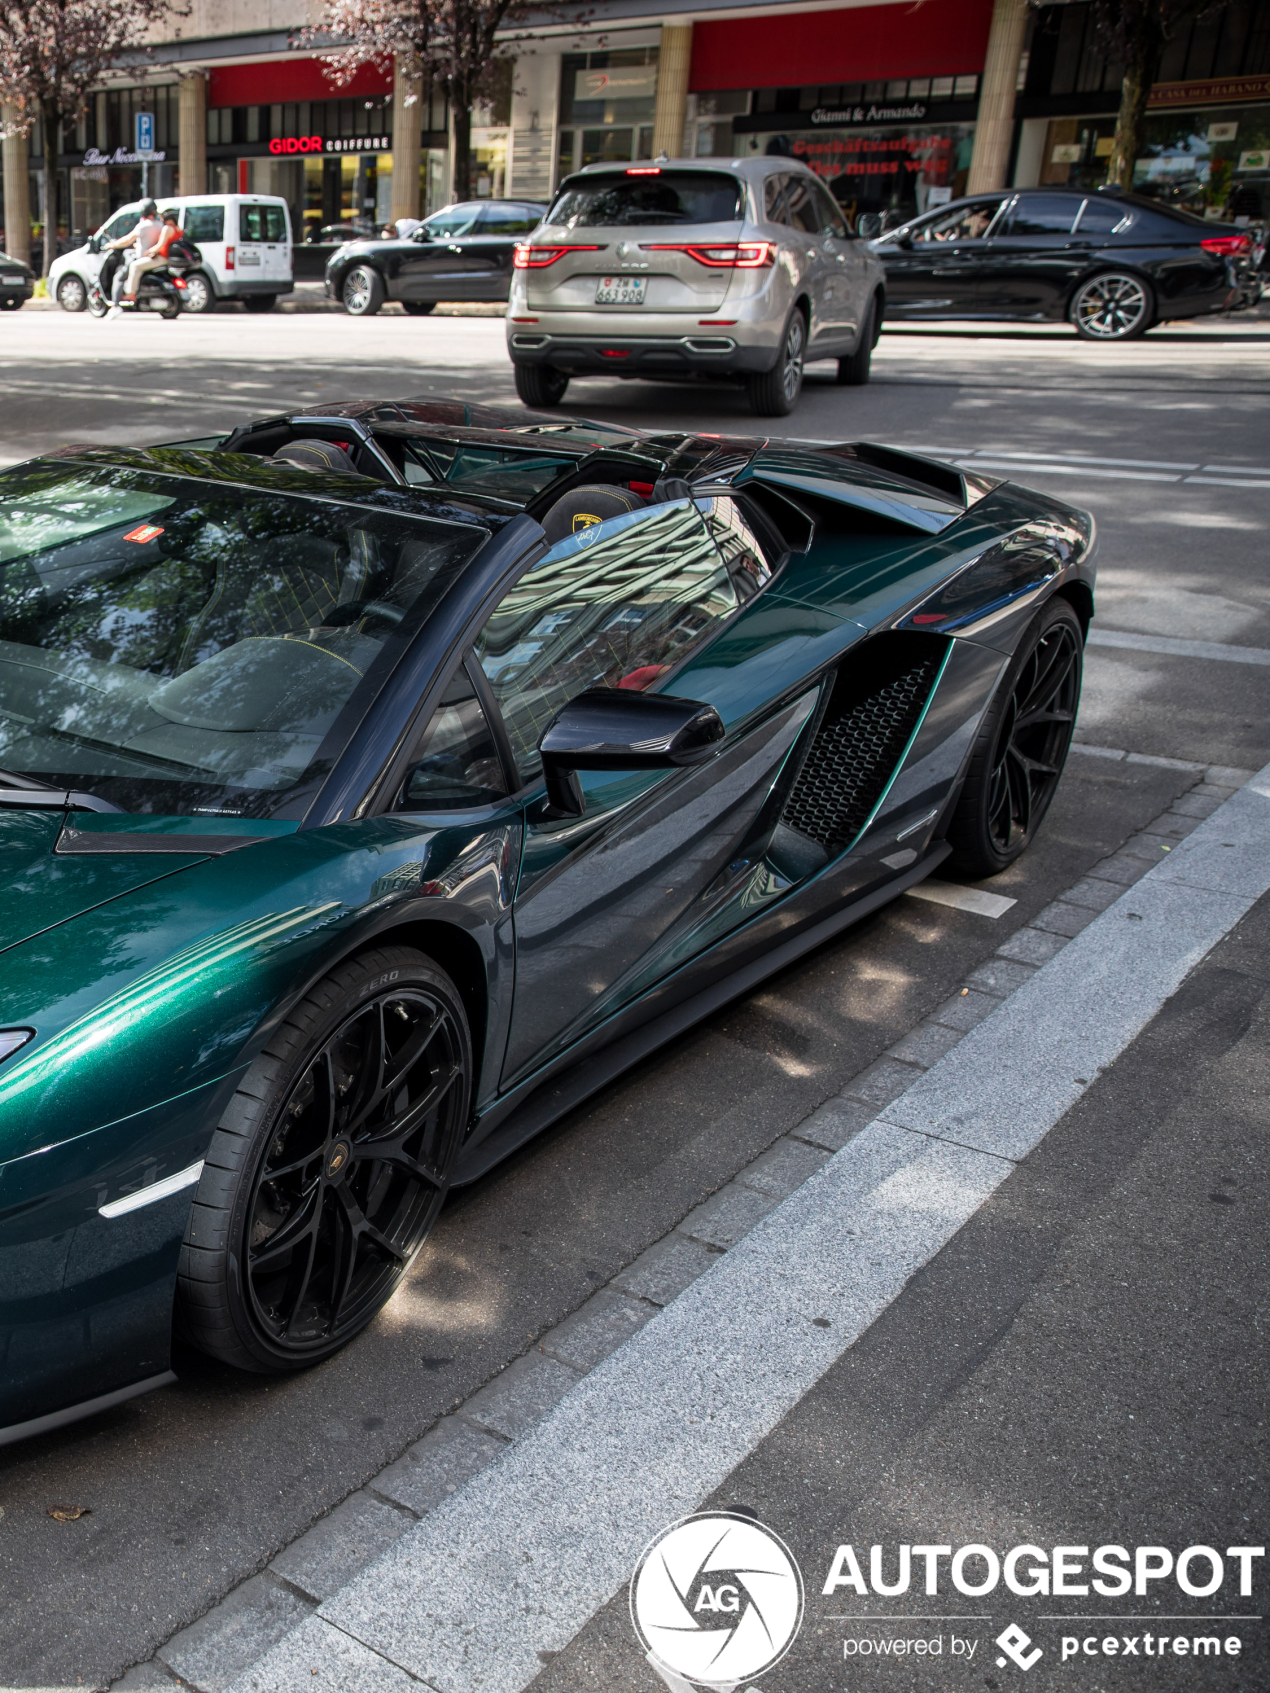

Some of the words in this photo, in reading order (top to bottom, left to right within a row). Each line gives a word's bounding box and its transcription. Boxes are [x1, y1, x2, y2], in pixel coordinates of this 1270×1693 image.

[1210, 82, 1262, 95] HABANO
[811, 108, 851, 123] Gianni
[853, 107, 865, 120] &
[866, 102, 926, 120] Armando
[269, 136, 323, 154] GIDOR
[326, 137, 388, 151] COIFFURE
[792, 136, 952, 155] Geschäftsaufgabe
[807, 161, 842, 175] lles
[845, 161, 899, 175] muss
[903, 159, 948, 174] weg
[359, 971, 399, 997] ZERO
